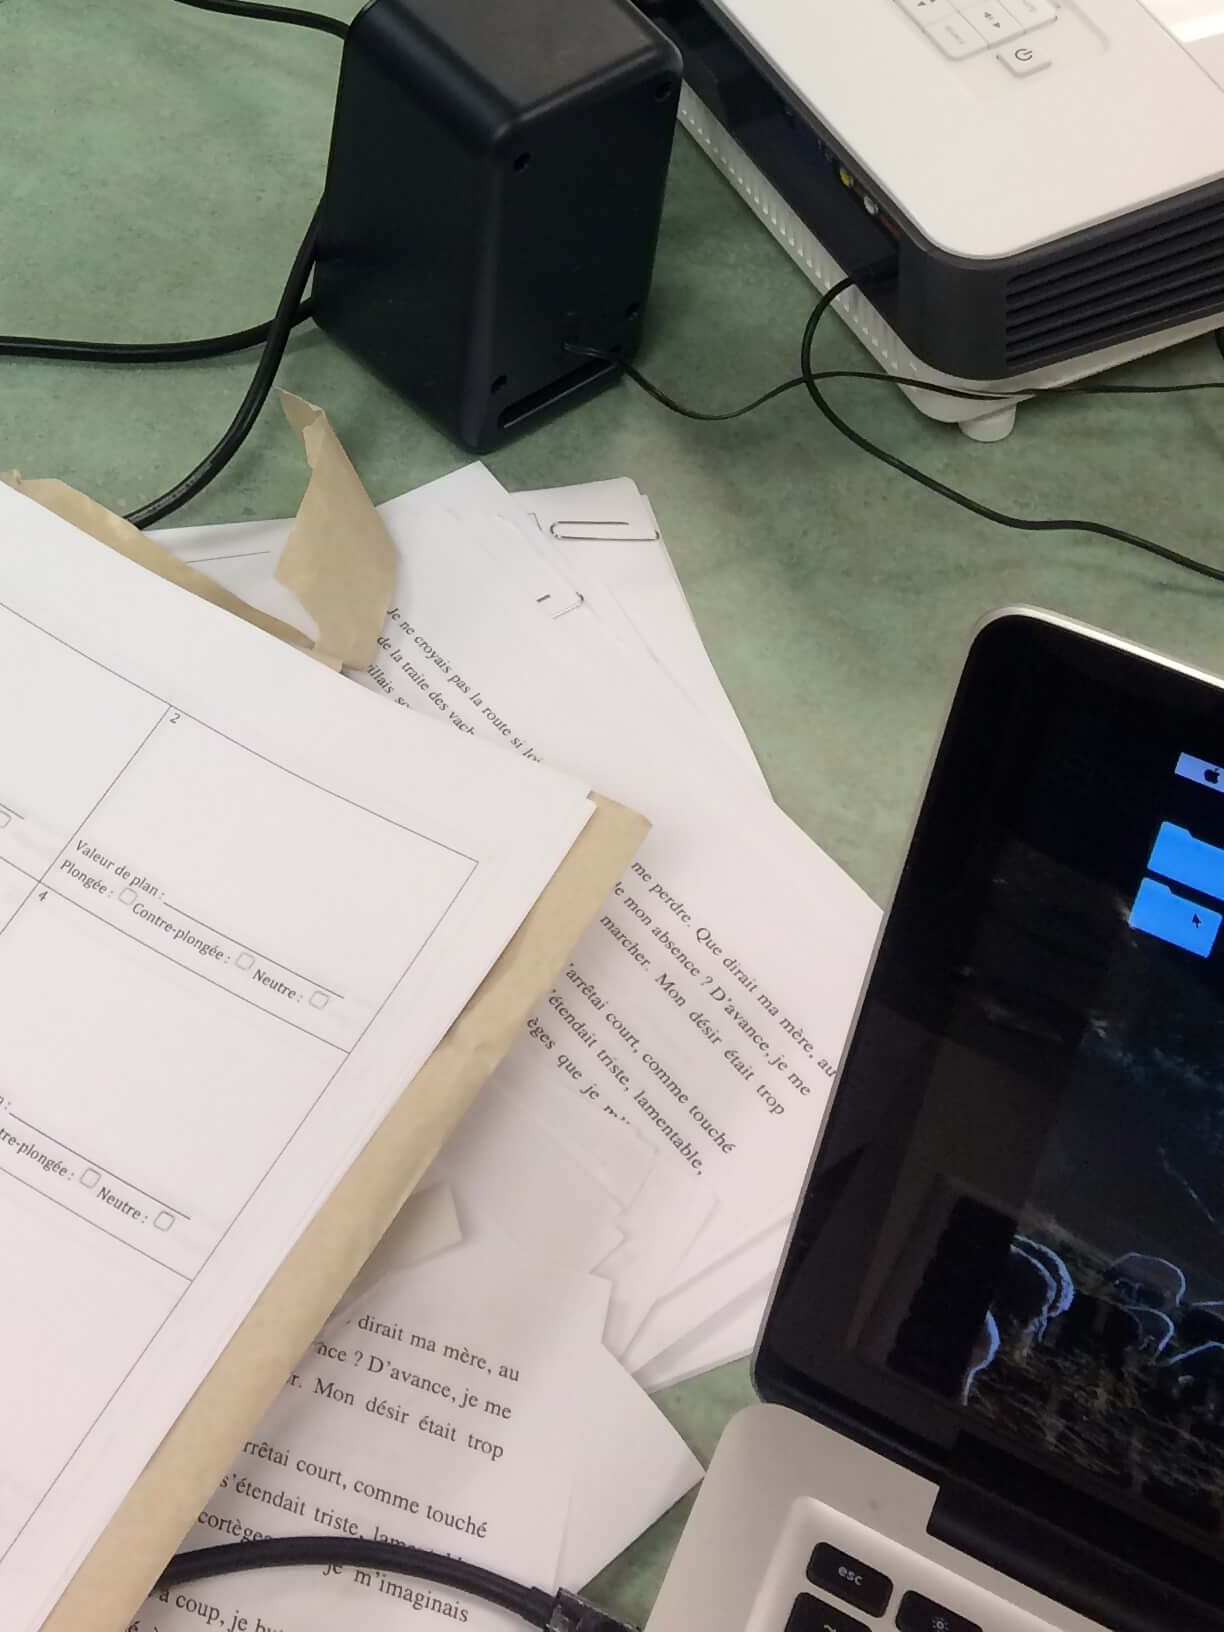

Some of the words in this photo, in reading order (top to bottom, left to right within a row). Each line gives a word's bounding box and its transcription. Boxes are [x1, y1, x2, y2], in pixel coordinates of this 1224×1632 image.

[169, 712, 181, 724] 2
[389, 648, 403, 663] la
[401, 661, 430, 691] traite
[428, 691, 449, 711] des
[399, 621, 415, 636] ne
[413, 636, 450, 674] croyais
[447, 674, 471, 694] pas
[468, 692, 483, 707] la
[481, 707, 512, 736] route
[510, 737, 523, 749] si
[37, 890, 47, 903] 4
[76, 839, 116, 870] Valeur
[114, 865, 131, 880] de
[128, 876, 159, 897] plan
[59, 859, 108, 894] Plongée
[132, 903, 225, 960] Contre-plongée
[252, 968, 297, 999] Neutre
[631, 862, 652, 882] me
[696, 927, 723, 956] Que
[722, 958, 758, 993] dirait
[756, 994, 780, 1017] ma
[778, 1017, 814, 1059] mère,
[623, 897, 653, 926] mon
[651, 926, 701, 977] absence
[771, 1054, 788, 1071] je
[787, 1072, 811, 1096] me
[527, 1017, 556, 1050] èges
[557, 1054, 583, 1080] que
[579, 1083, 600, 1100] je
[605, 1013, 640, 1054] court,
[642, 1053, 689, 1104] comme
[688, 1105, 737, 1154] touché
[655, 972, 686, 1007] Mon
[688, 1011, 722, 1044] désir
[723, 1049, 755, 1081] était
[756, 1084, 785, 1115] trop
[596, 1049, 630, 1092] triste,
[633, 1090, 703, 1176] lamentable,
[96, 1186, 142, 1220] Neutre
[357, 1314, 404, 1342] dirait
[409, 1334, 436, 1353] ma
[442, 1345, 492, 1375] mère,
[498, 1365, 520, 1382] au
[314, 1377, 355, 1406] Mon
[365, 1396, 410, 1424] désir
[418, 1415, 457, 1442] était
[467, 1434, 504, 1462] trop
[458, 1387, 479, 1409] je
[484, 1400, 512, 1420] me
[296, 1459, 347, 1490] court,
[353, 1480, 420, 1514] comme
[426, 1505, 488, 1539] touché
[838, 1565, 863, 1586] esc
